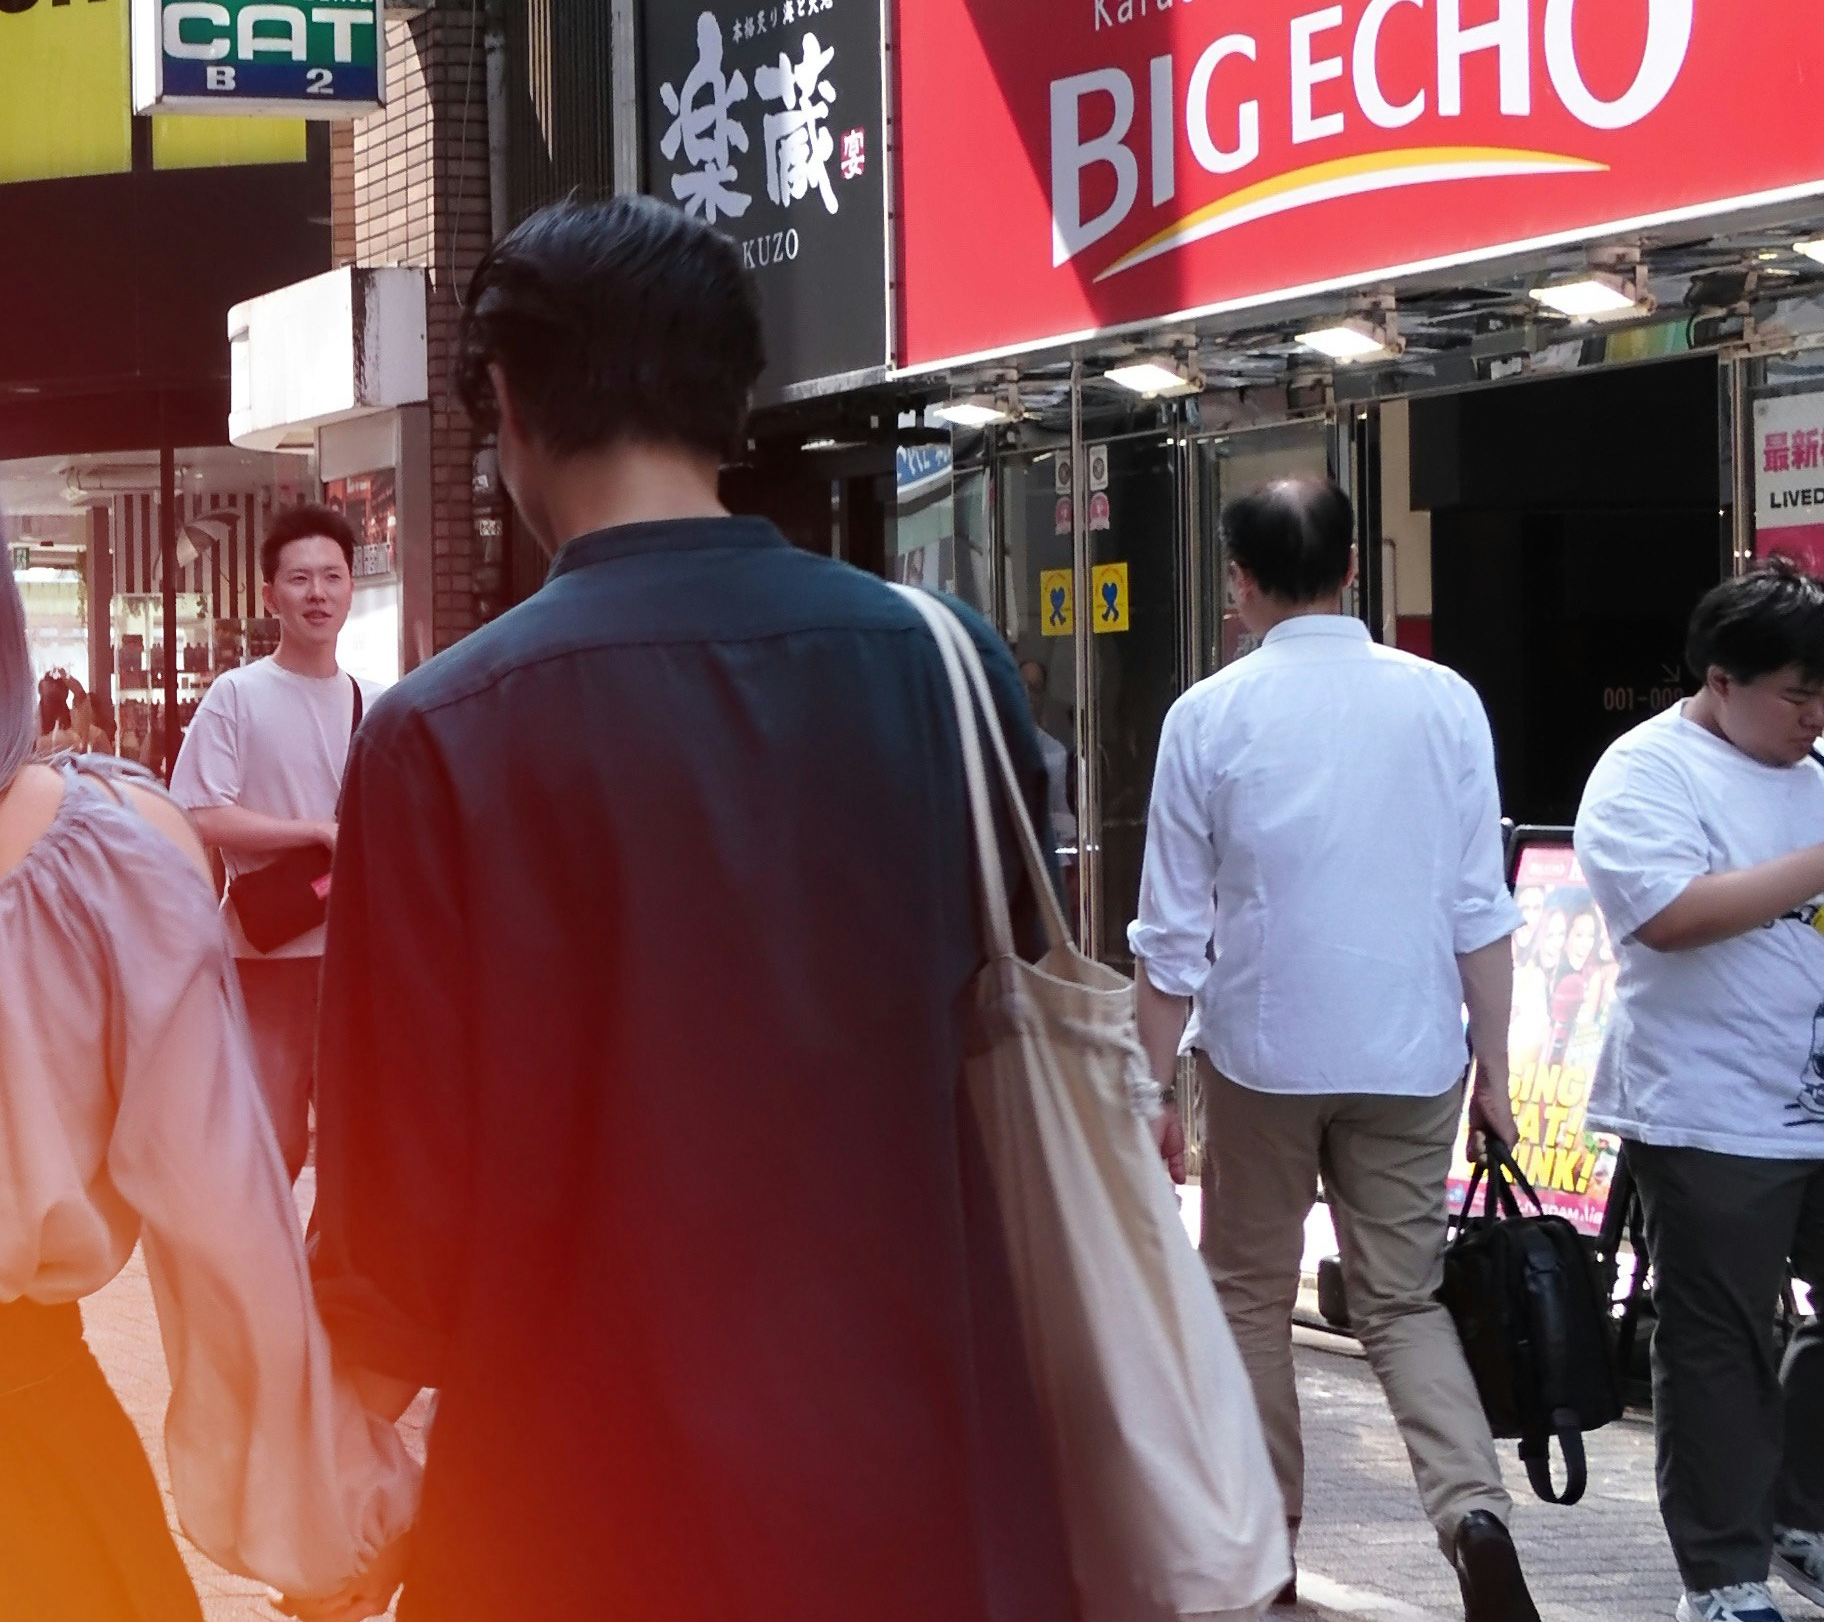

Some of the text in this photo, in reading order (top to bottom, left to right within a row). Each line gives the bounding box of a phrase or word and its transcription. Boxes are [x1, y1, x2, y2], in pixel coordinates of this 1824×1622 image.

[164, 2, 374, 63] CAT
[659, 11, 840, 225] 楽蔵
[1050, 34, 1260, 269] BIG
[742, 227, 800, 272] KUZO
[1763, 429, 1824, 472] 最新
